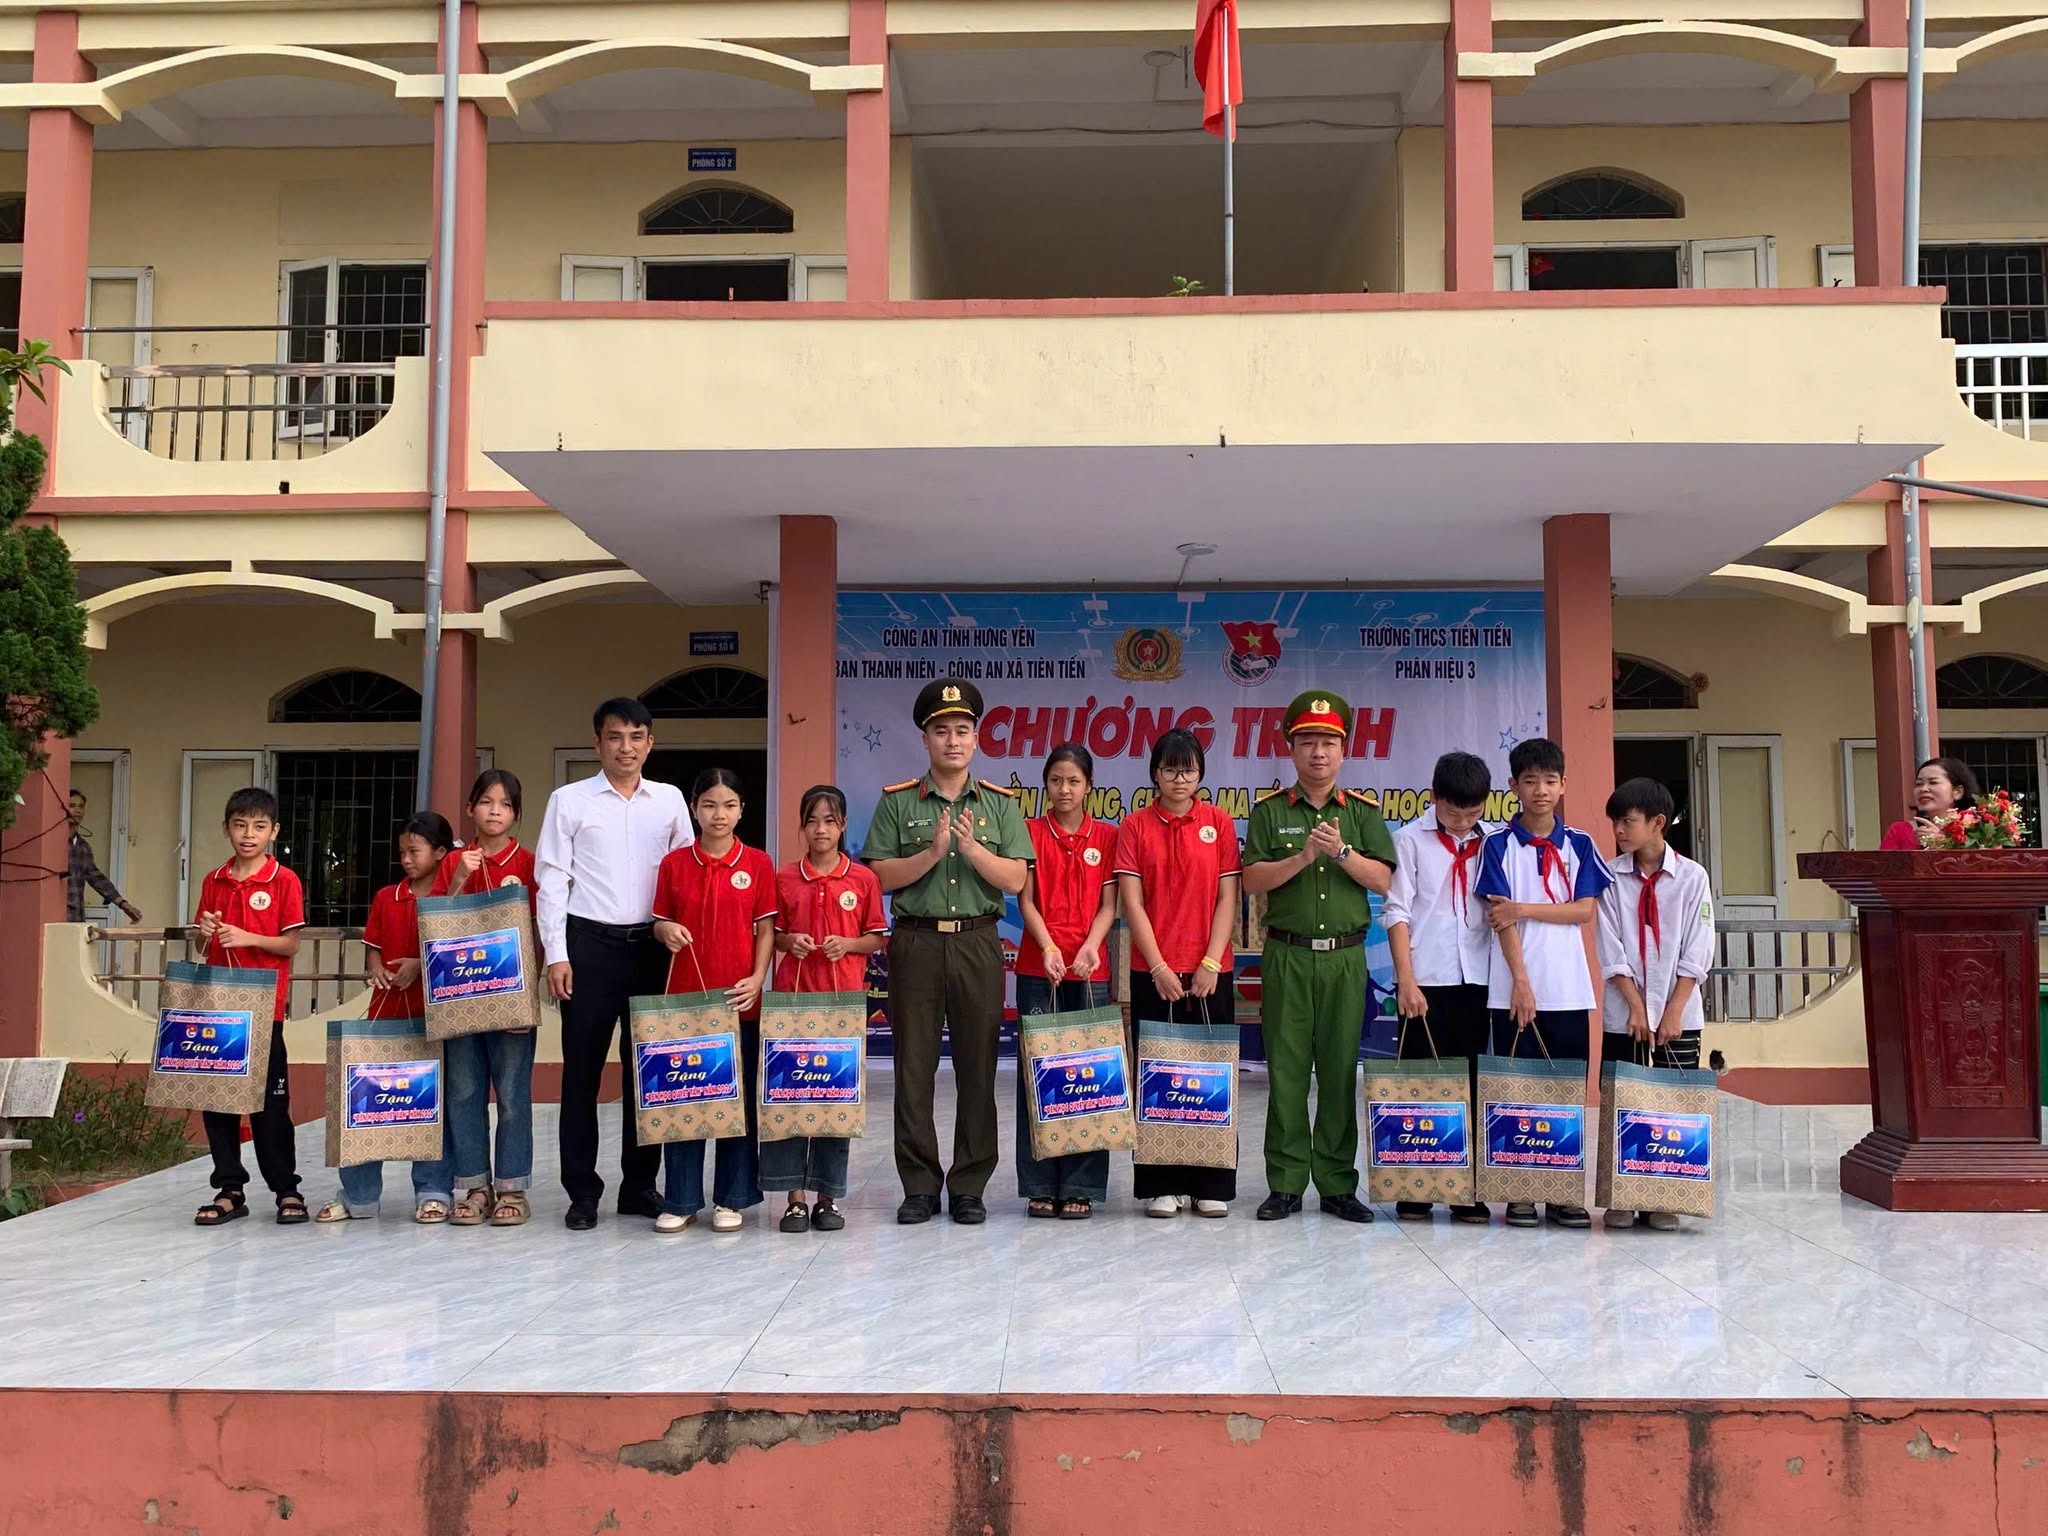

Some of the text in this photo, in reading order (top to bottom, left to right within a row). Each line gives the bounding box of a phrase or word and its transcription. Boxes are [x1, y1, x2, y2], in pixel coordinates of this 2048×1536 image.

[883, 622, 1035, 647] CÔNG AN TỈNH HƯNG YÊN
[1360, 622, 1512, 647] TRƯỜNG THCS TIÊN TIẾN
[861, 660, 902, 678] THANH
[905, 657, 936, 679] NIÊN
[948, 657, 982, 679] CÔNG
[985, 660, 1003, 679] AN
[1006, 657, 1024, 679] XÃ
[1027, 657, 1055, 679] TIÊN
[1058, 654, 1086, 679] TIẾN
[1395, 657, 1476, 683] PHÂN HIỆU 3
[978, 695, 1396, 760] CHƯƠNG TRH
